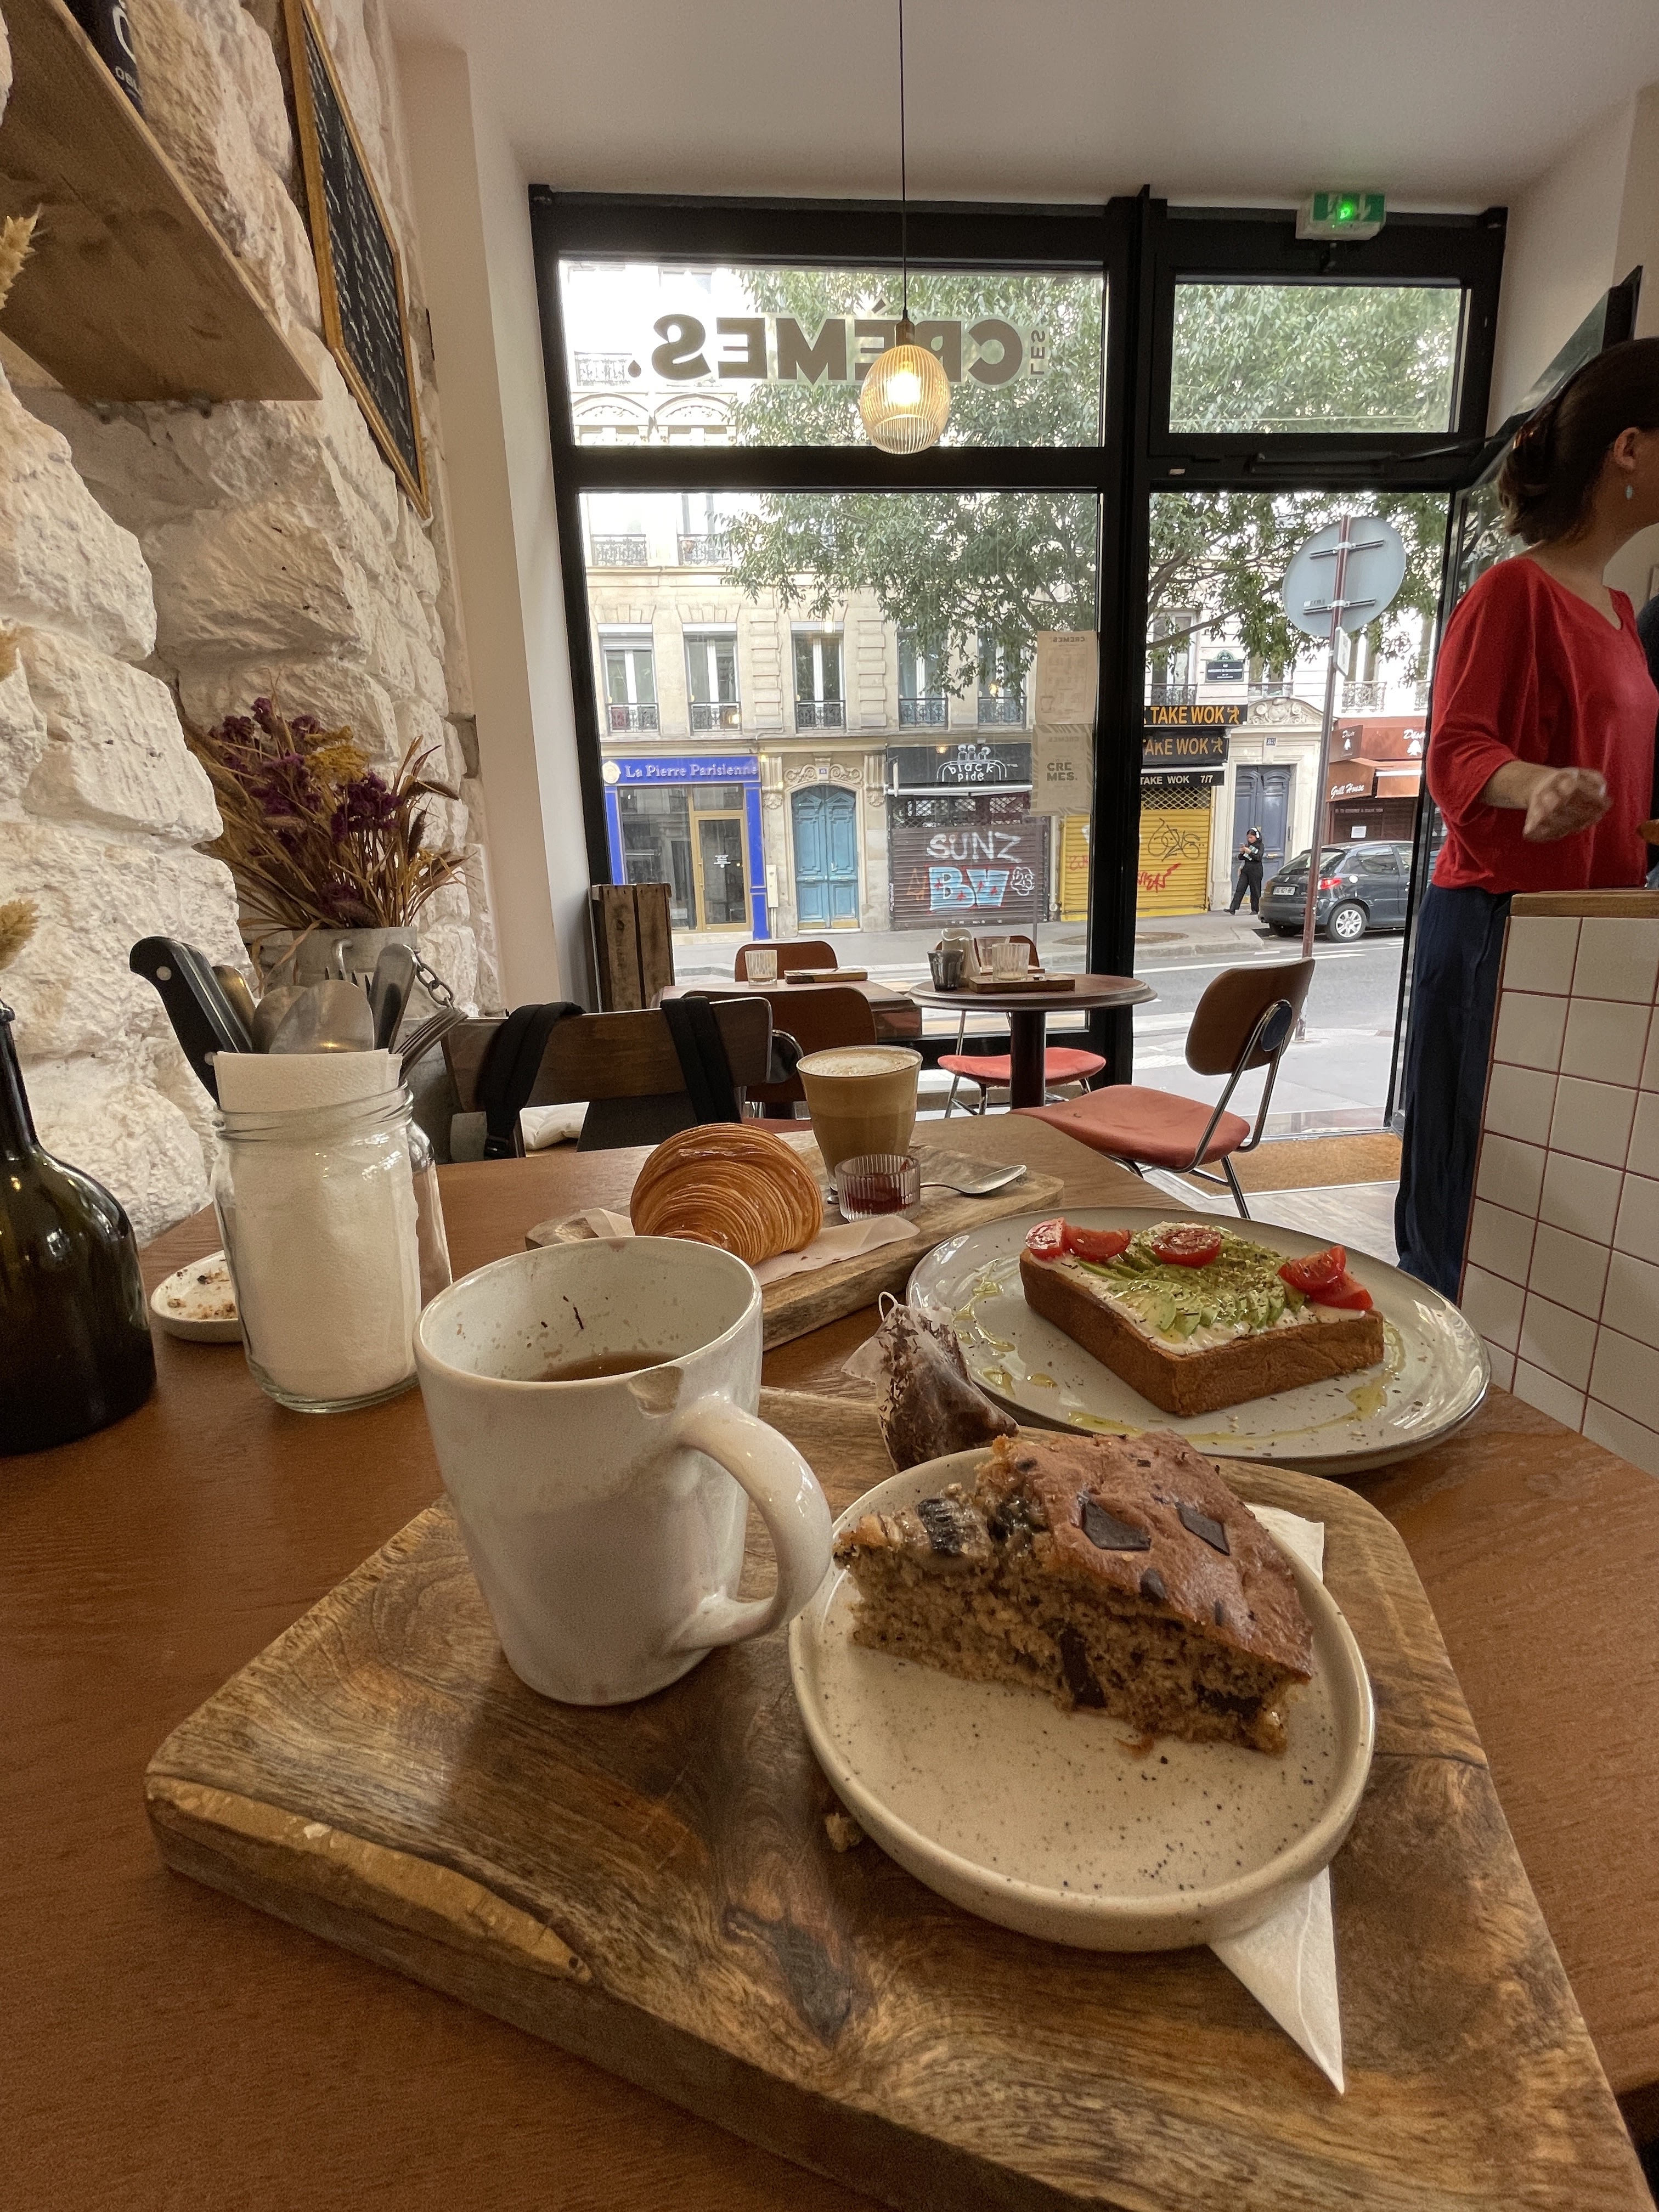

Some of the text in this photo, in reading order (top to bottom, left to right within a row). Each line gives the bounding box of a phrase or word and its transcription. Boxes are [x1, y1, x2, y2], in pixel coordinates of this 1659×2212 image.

[1150, 705, 1225, 724] TAKE WOK
[1143, 737, 1209, 755] AKE WOK
[624, 763, 758, 778] La Pierre Parisienne
[947, 762, 994, 775] black
[1047, 762, 1072, 771] CRE
[958, 771, 985, 782] pide
[1047, 771, 1077, 781] MES.
[1167, 775, 1190, 784] WOK
[1200, 775, 1214, 783] 7/7
[1345, 782, 1364, 794] House
